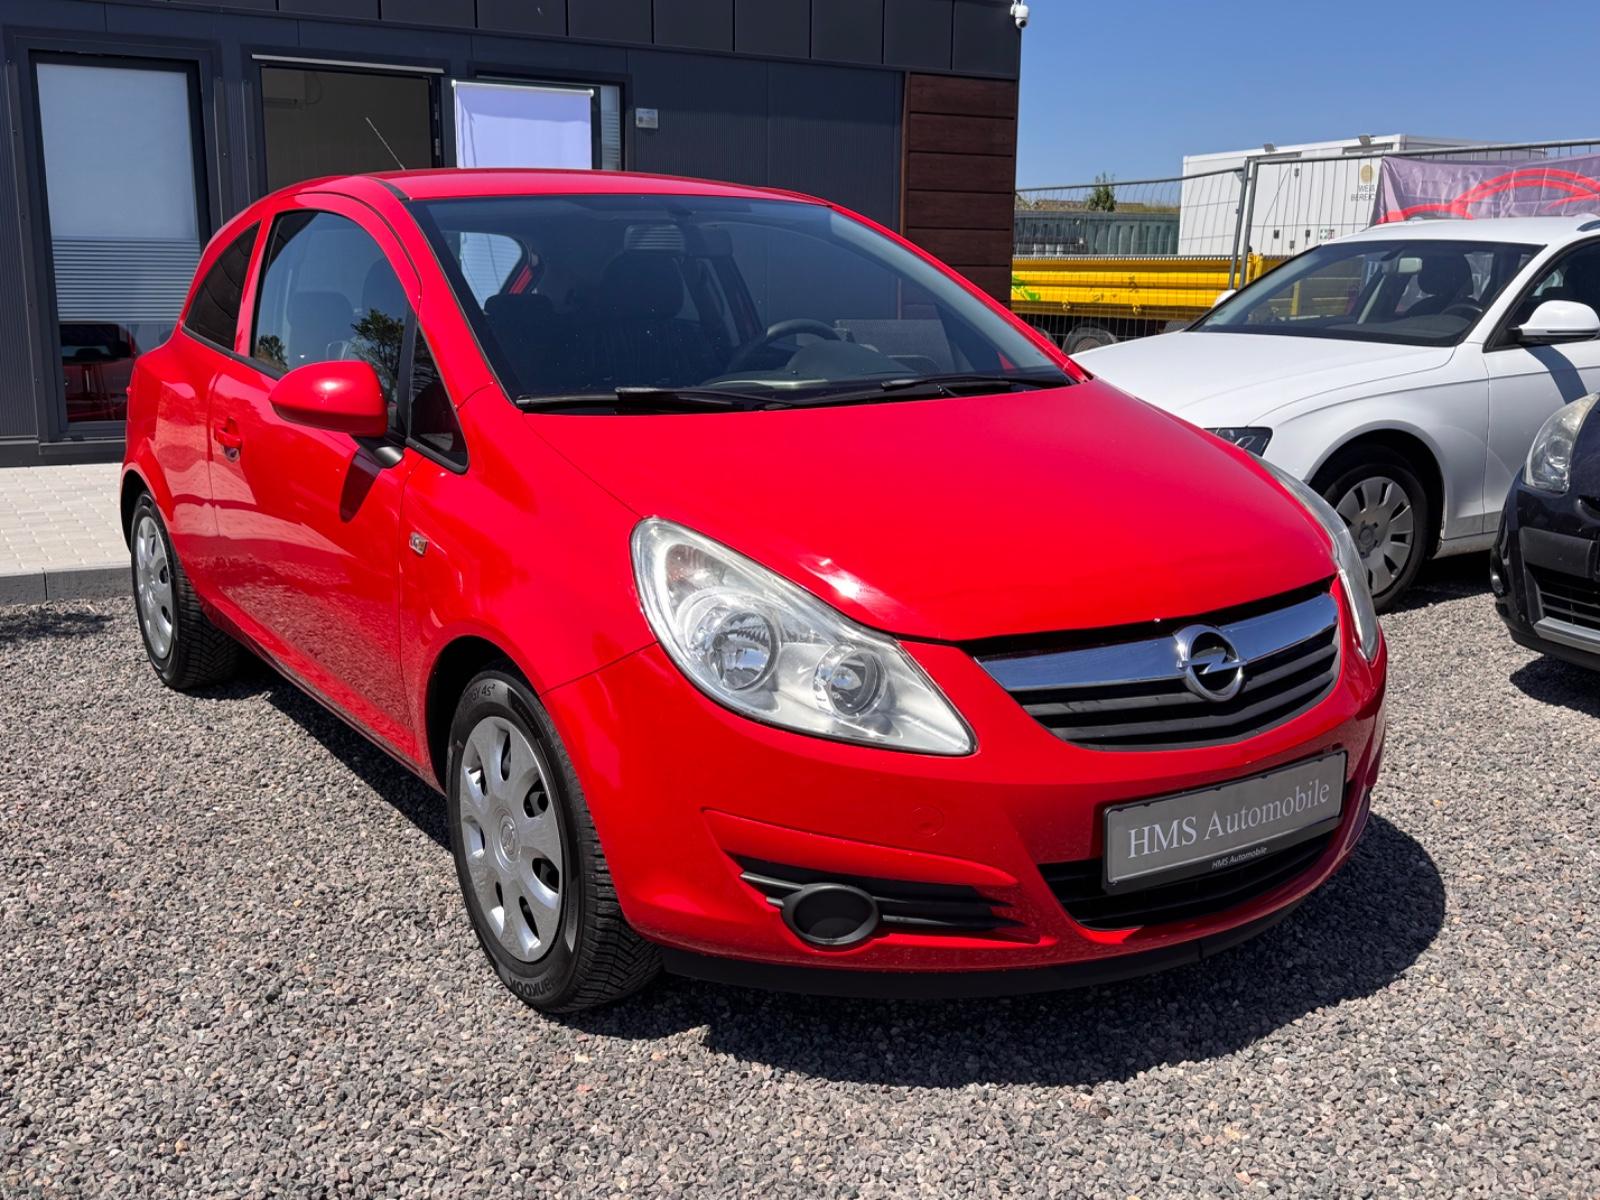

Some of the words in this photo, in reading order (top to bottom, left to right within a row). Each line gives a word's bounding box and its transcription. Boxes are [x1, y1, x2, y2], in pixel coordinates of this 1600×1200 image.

[1127, 816, 1198, 860] HMS
[1202, 778, 1330, 841] Automobile
[1211, 856, 1229, 870] HMS
[1229, 847, 1268, 865] Automobile
